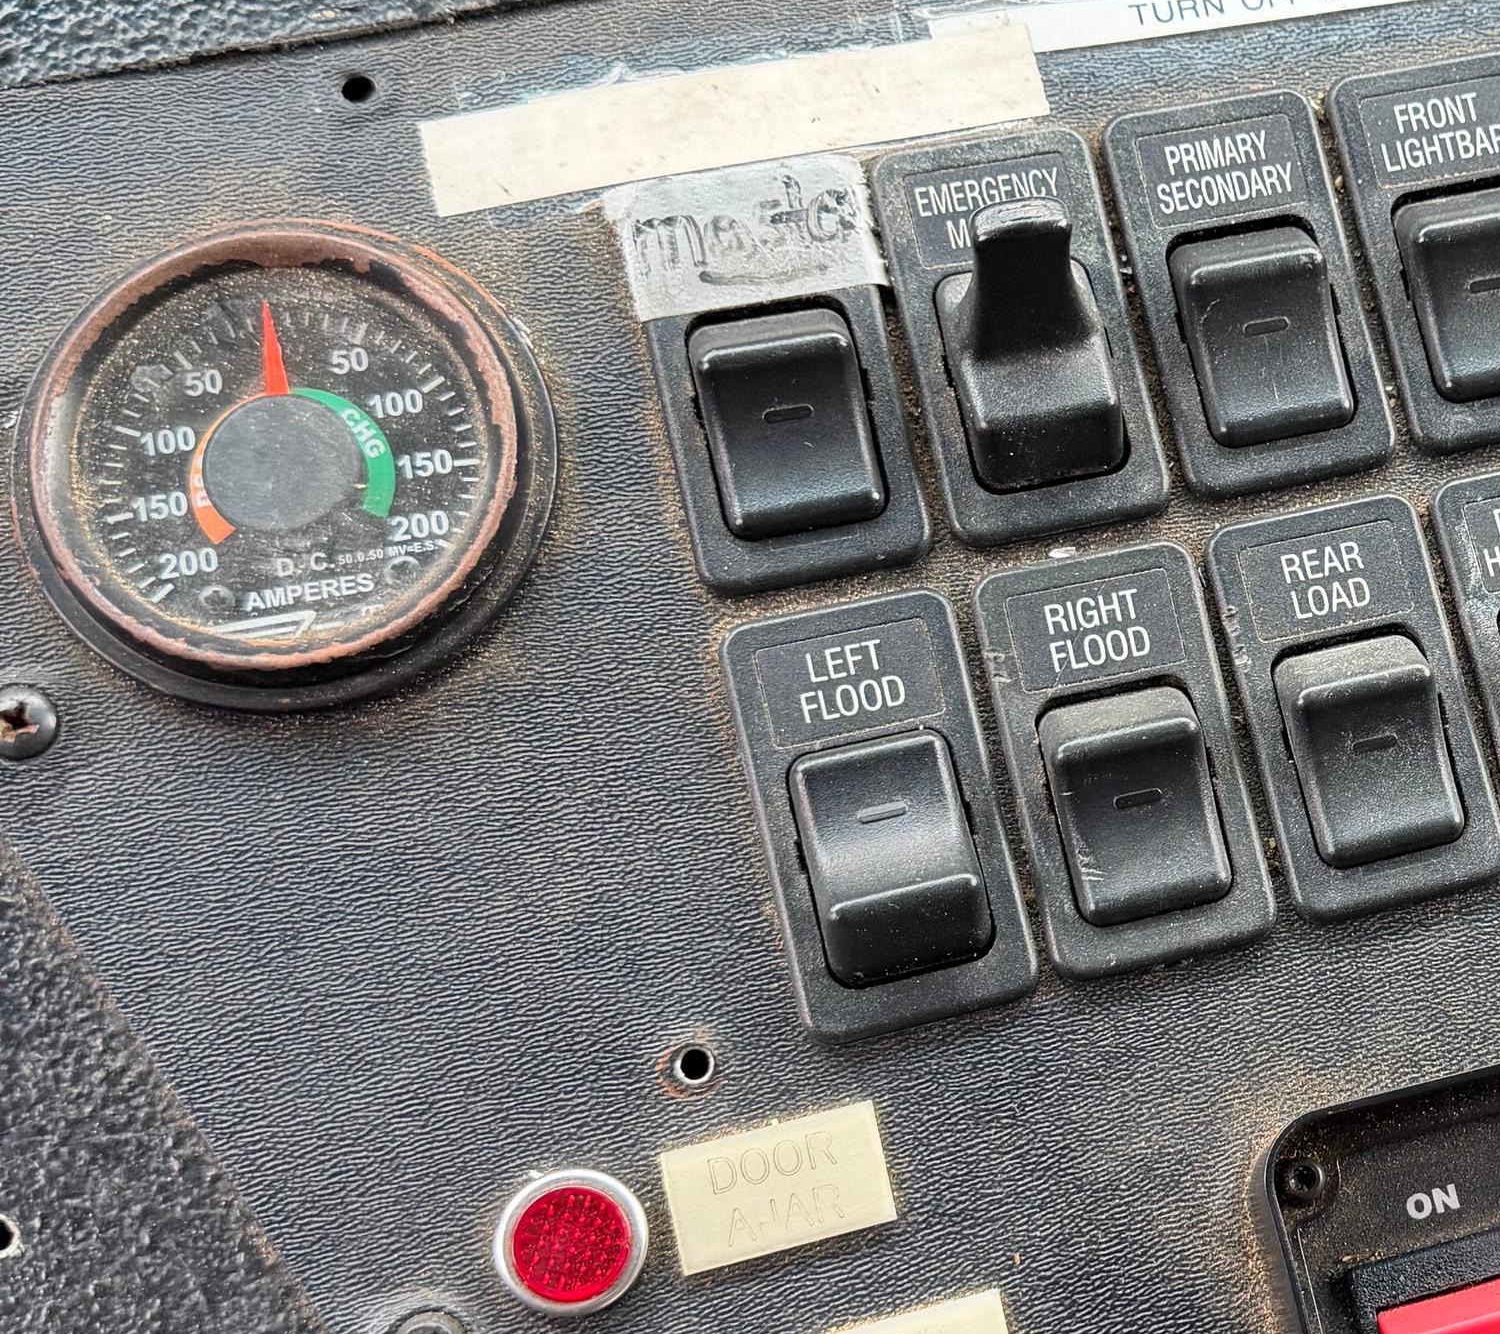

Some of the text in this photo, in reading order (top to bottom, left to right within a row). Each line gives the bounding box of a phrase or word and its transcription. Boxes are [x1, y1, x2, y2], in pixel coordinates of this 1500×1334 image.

[1392, 91, 1479, 134] FRONT
[1163, 129, 1268, 176] PRIMARY
[913, 166, 1059, 218] EMERGENCY
[1156, 162, 1295, 216] SECONDARY
[330, 346, 369, 376] 50
[185, 369, 223, 397] 50
[370, 388, 424, 419] 100
[139, 425, 197, 457] 100
[338, 408, 386, 460] CHG
[397, 447, 455, 481] 150
[130, 489, 189, 524] 150
[389, 509, 450, 544] 200
[158, 546, 220, 582] 200
[1280, 541, 1365, 584] REAR
[246, 572, 376, 611] AMPERES
[1043, 589, 1140, 635] RIGHT
[1290, 577, 1372, 620] LOAD
[804, 640, 883, 685] LEFT
[1049, 626, 1152, 674] FLOOD
[800, 675, 906, 725] FLOOD
[707, 1130, 838, 1195] DOOR
[728, 1182, 846, 1248] AJAR
[1405, 1183, 1461, 1220] ON
